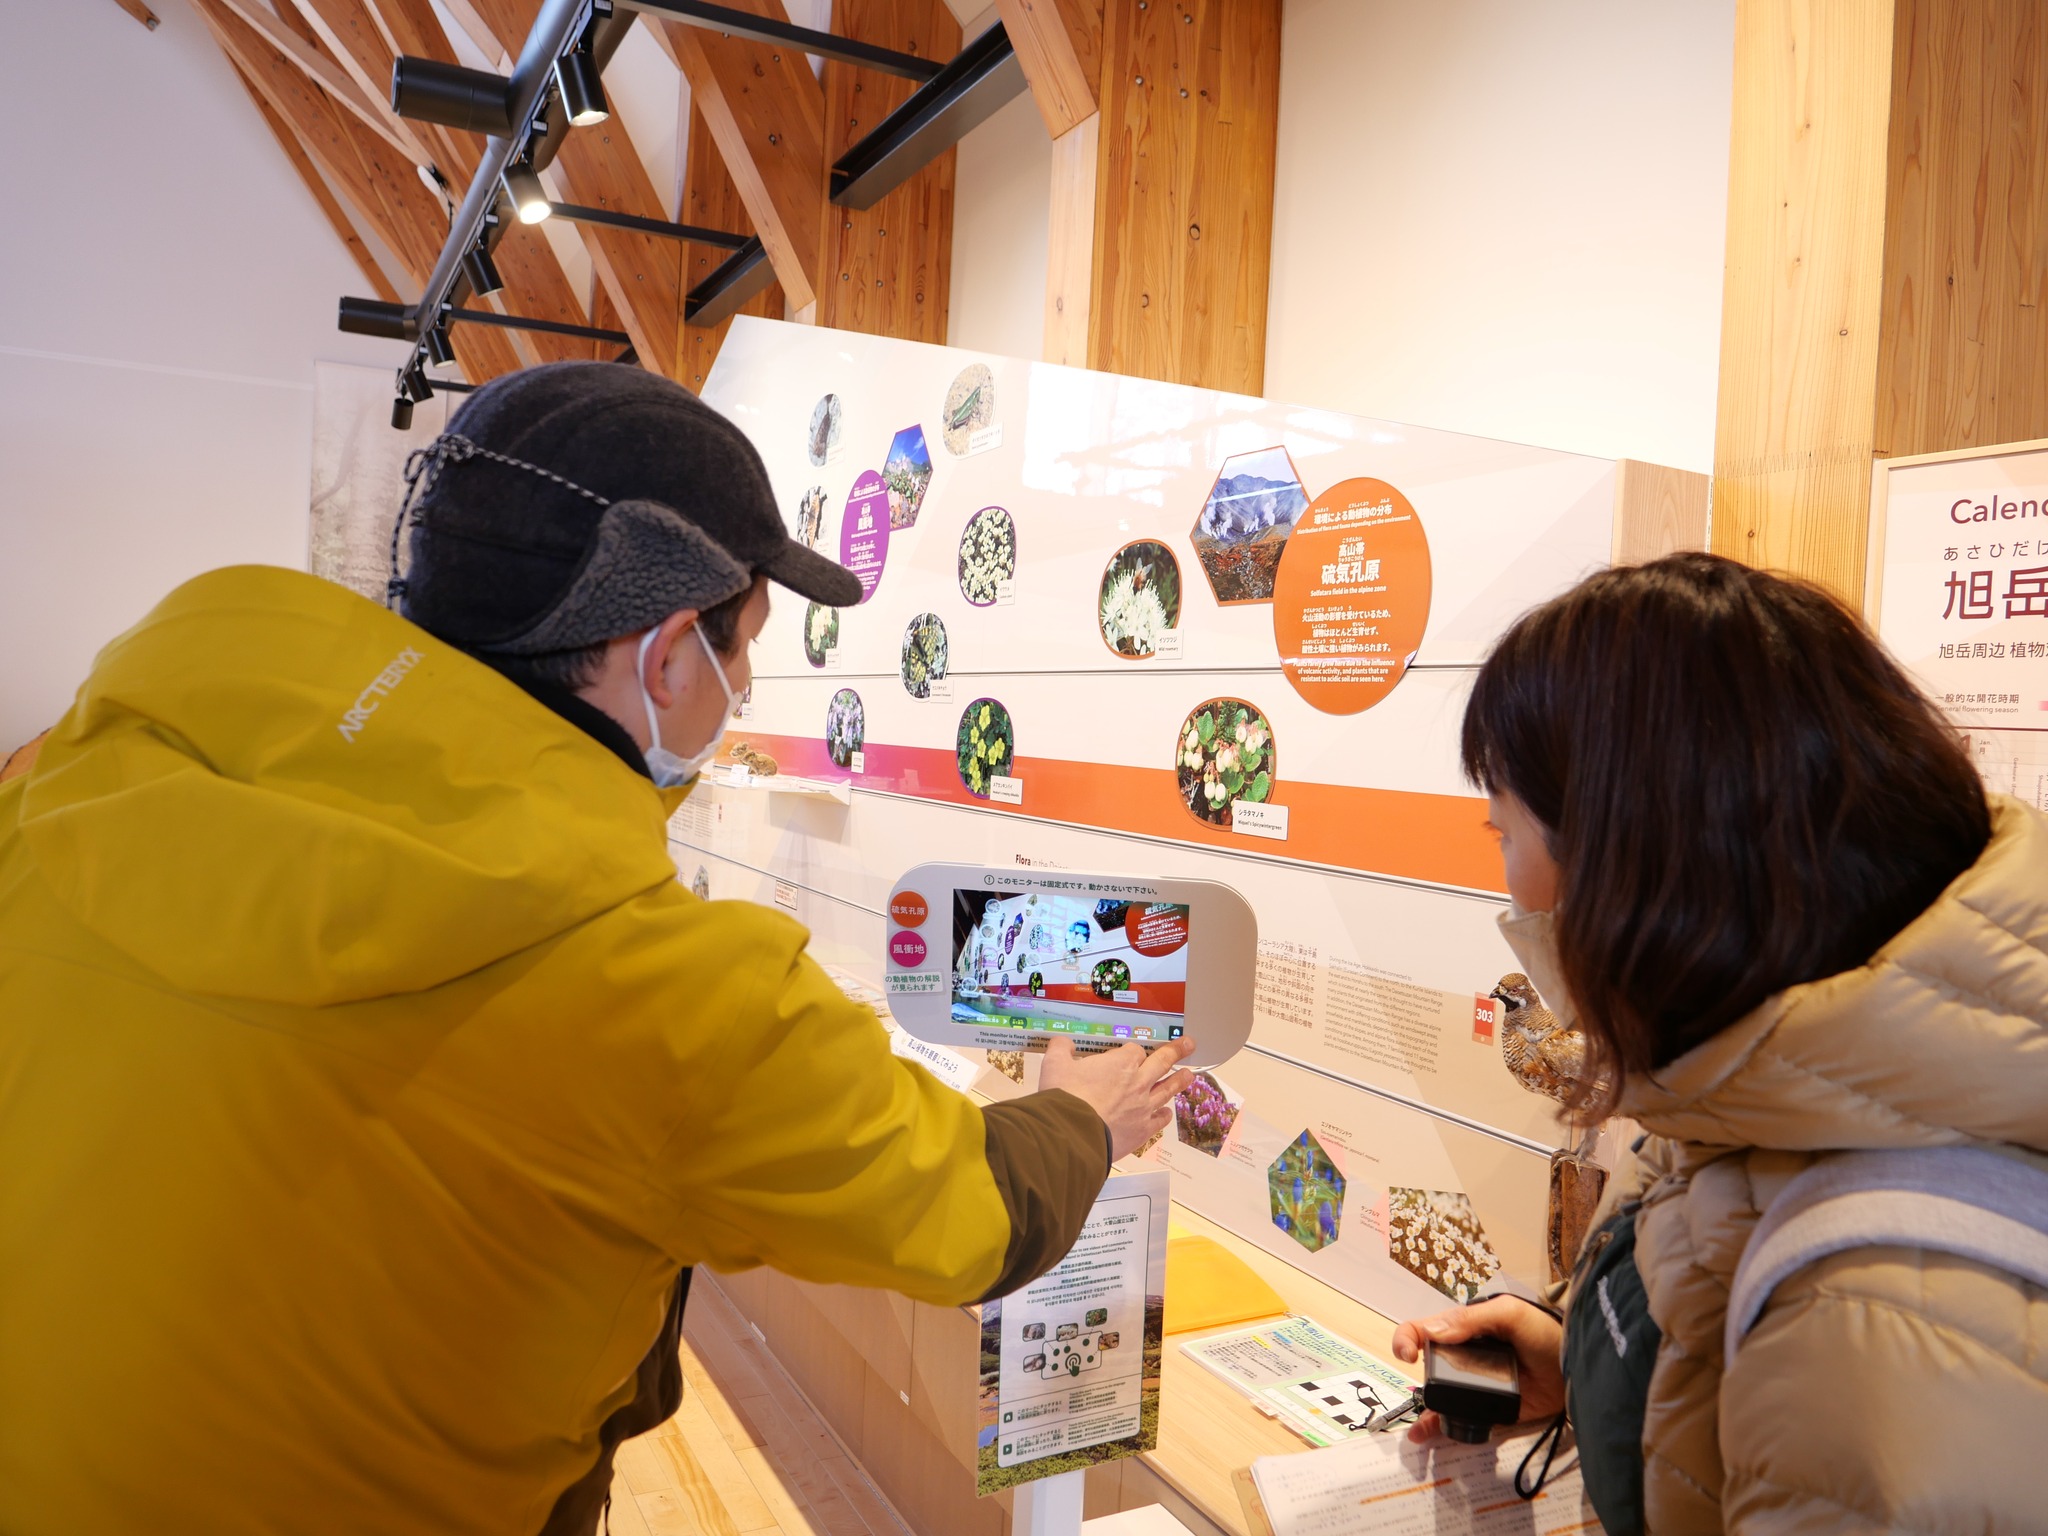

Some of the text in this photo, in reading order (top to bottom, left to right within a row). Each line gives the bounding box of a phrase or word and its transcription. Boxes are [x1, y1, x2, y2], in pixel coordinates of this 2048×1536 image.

[1339, 542, 1365, 557] 高山帯
[1321, 559, 1380, 584] 硫気孔原
[1939, 641, 2048, 659] 旭岳周辺 植物
[1935, 694, 2019, 704] 一般的な開花時期
[1962, 705, 1993, 714] flowering
[1016, 854, 1031, 866] Flora
[997, 876, 1158, 895] このモニターは固定式です。動かさないで下さい。
[891, 905, 925, 915] 硫気孔原
[893, 944, 925, 954] 風衝地
[885, 975, 940, 983] の動植物の解説
[891, 984, 935, 992] が見られます
[1476, 1008, 1493, 1023] 303
